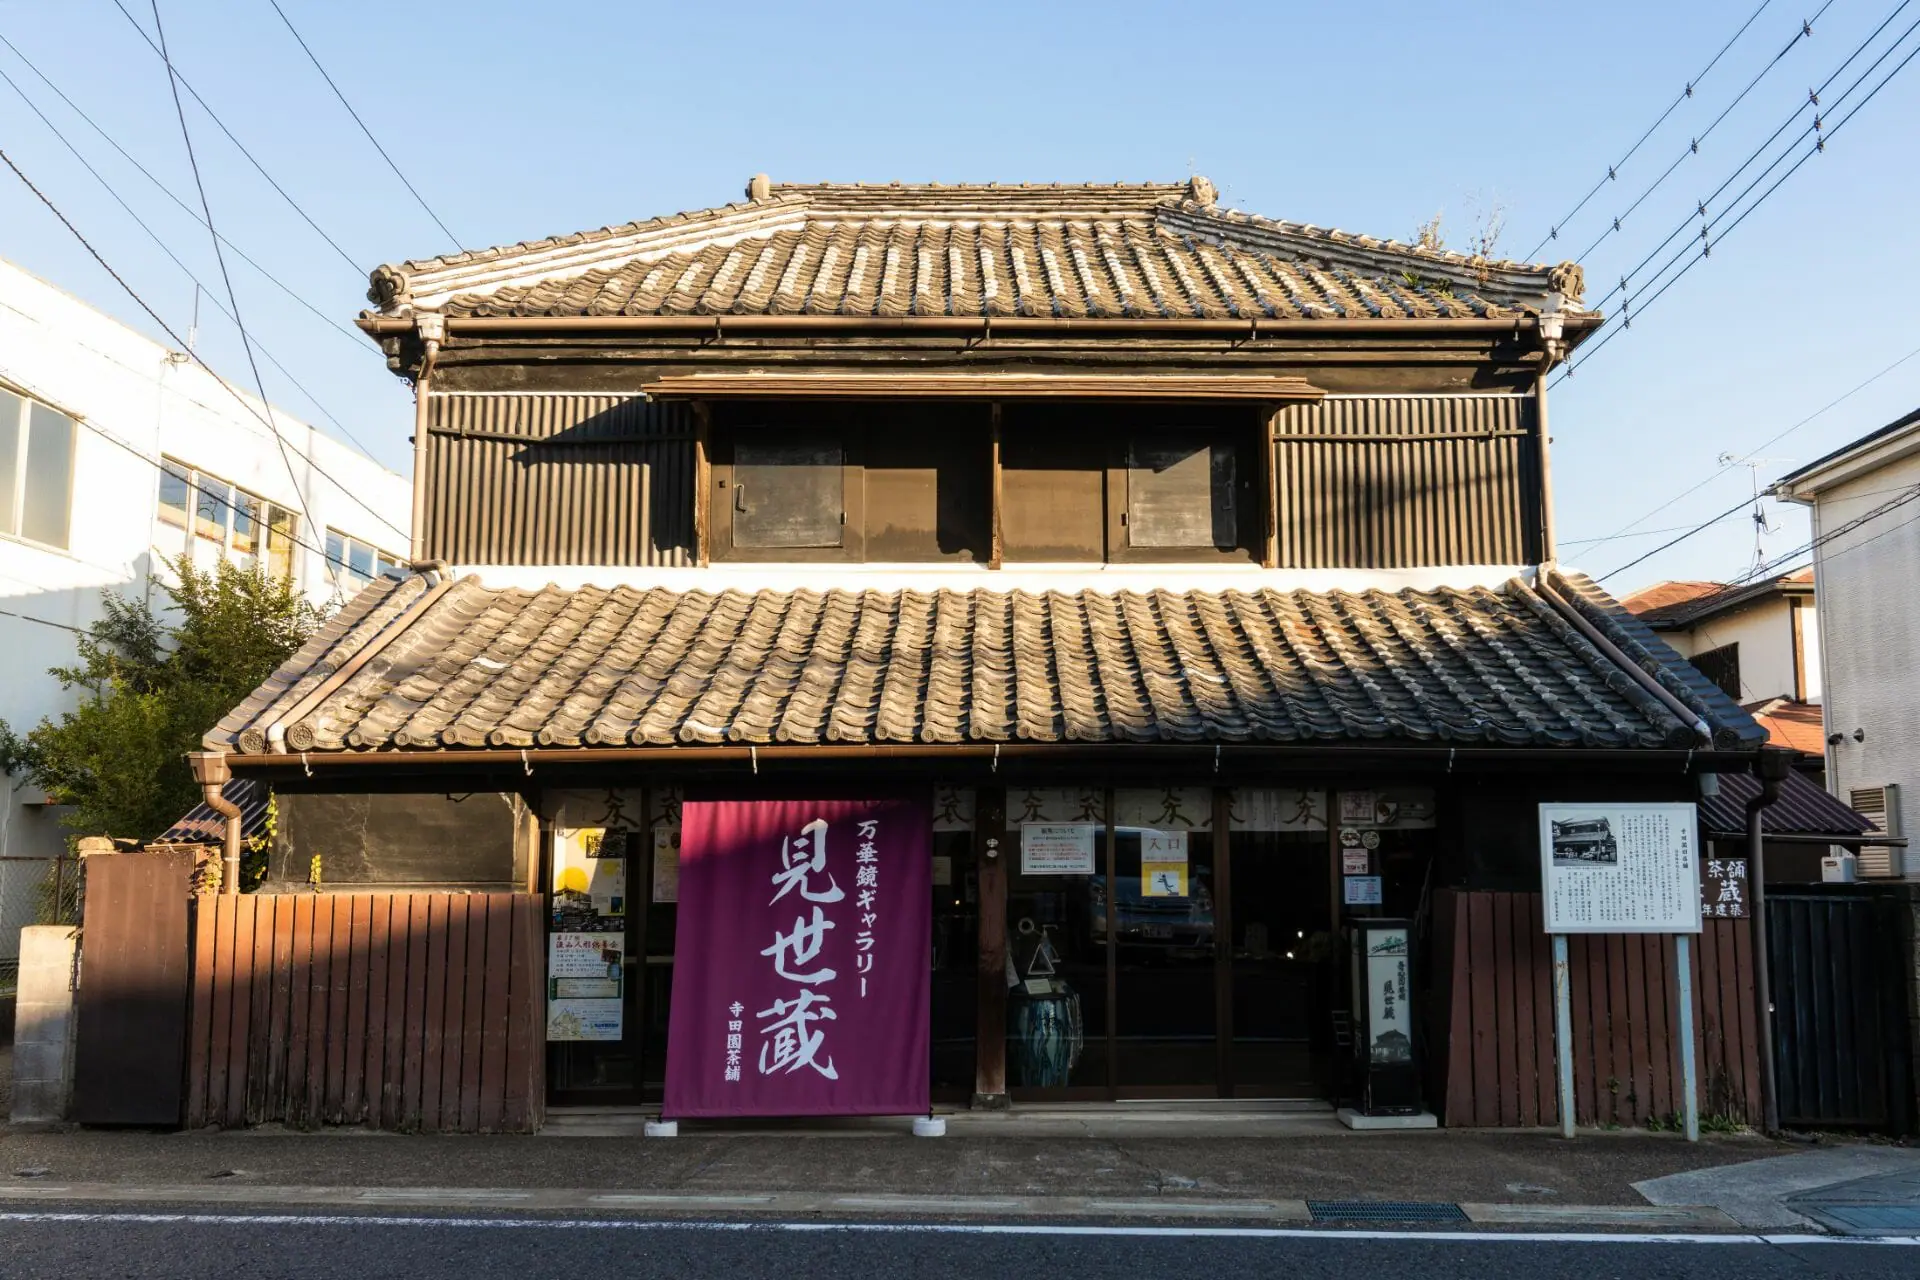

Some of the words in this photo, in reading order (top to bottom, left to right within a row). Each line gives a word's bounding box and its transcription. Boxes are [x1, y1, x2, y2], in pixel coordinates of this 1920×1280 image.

[1149, 838, 1180, 850] 入口
[1708, 860, 1745, 879] 茶舗
[856, 819, 878, 998] 万華鏡ギャラリー
[757, 819, 845, 1080] 見世蔵
[1382, 980, 1396, 1020] 見世蔵
[725, 1002, 745, 1081] 寺田園茶舗
